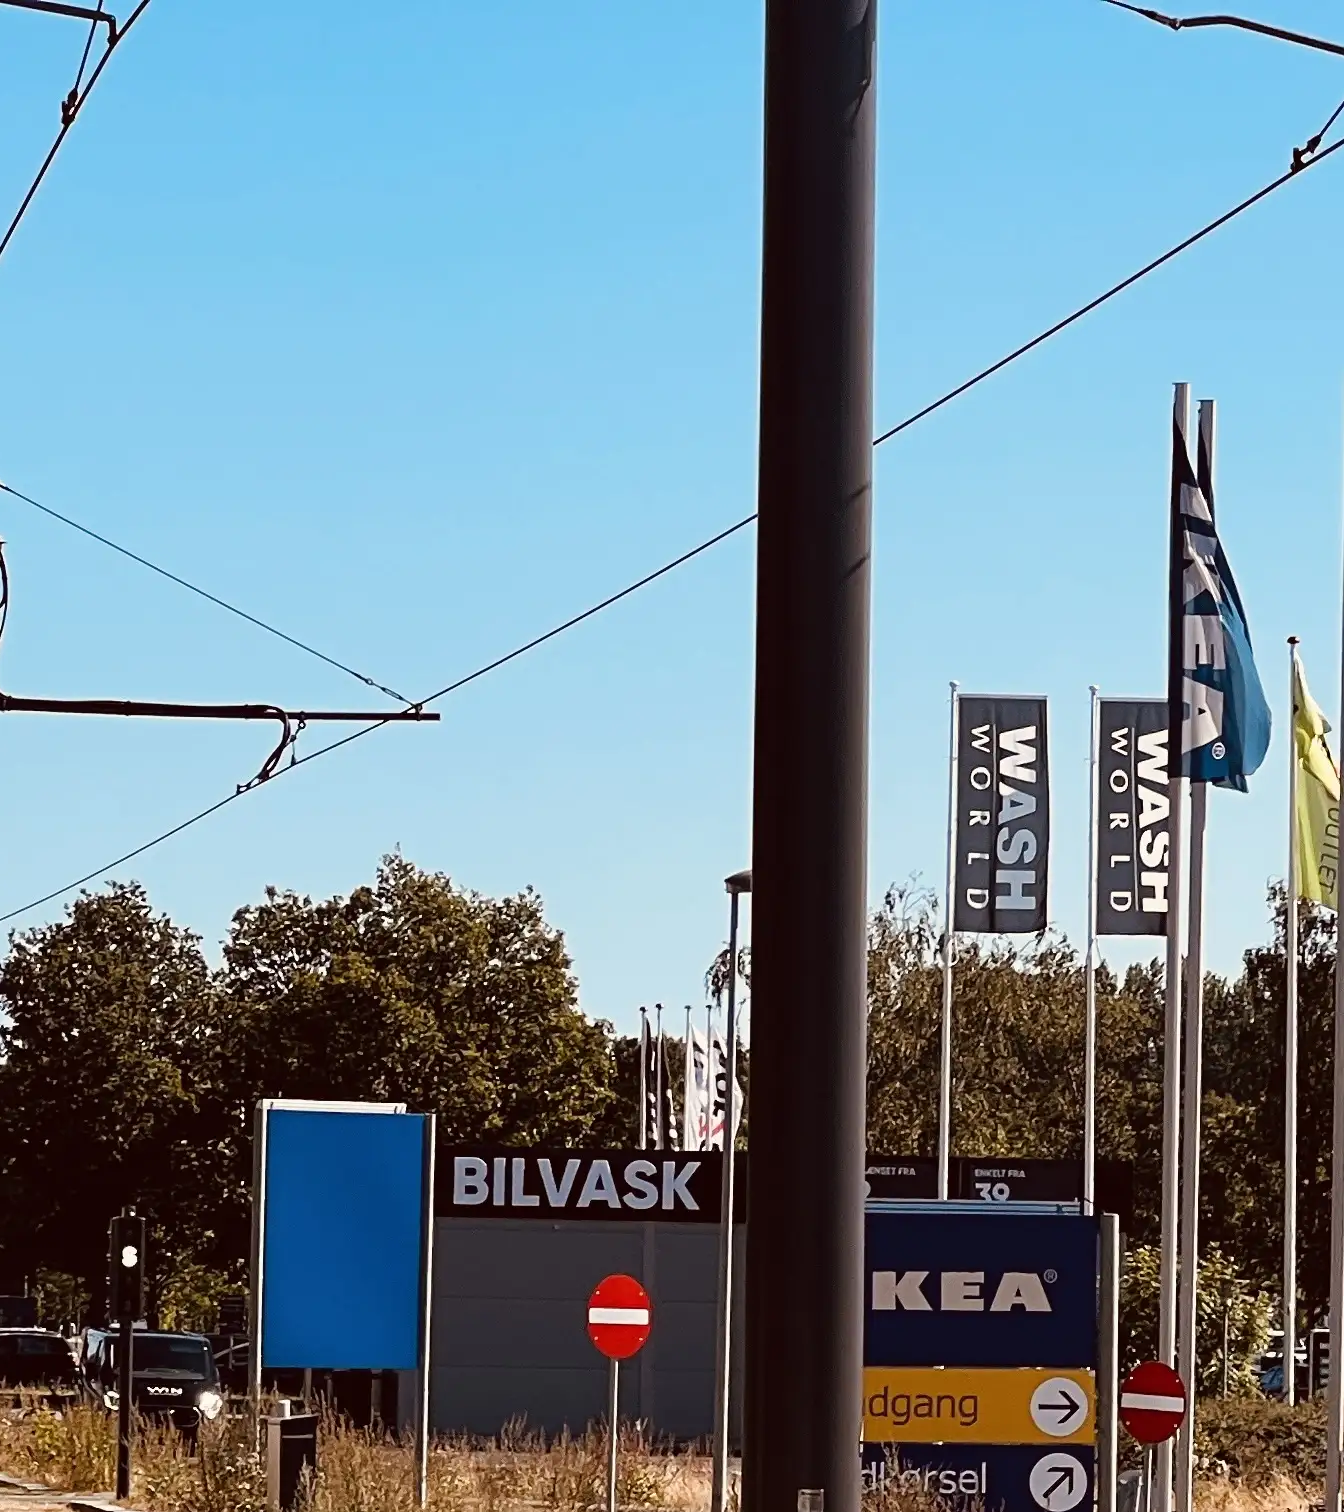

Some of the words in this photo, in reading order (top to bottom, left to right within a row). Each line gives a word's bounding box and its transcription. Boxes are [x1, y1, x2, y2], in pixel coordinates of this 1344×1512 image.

[966, 723, 991, 910] WORLD
[995, 725, 1038, 910] WASH
[1109, 727, 1132, 912] WORLD
[1137, 729, 1170, 914] WASH
[453, 1156, 702, 1211] BILVASK
[864, 1166, 896, 1176] ÆNSET
[871, 1270, 1053, 1312] KEA
[862, 1385, 979, 1426] dgang
